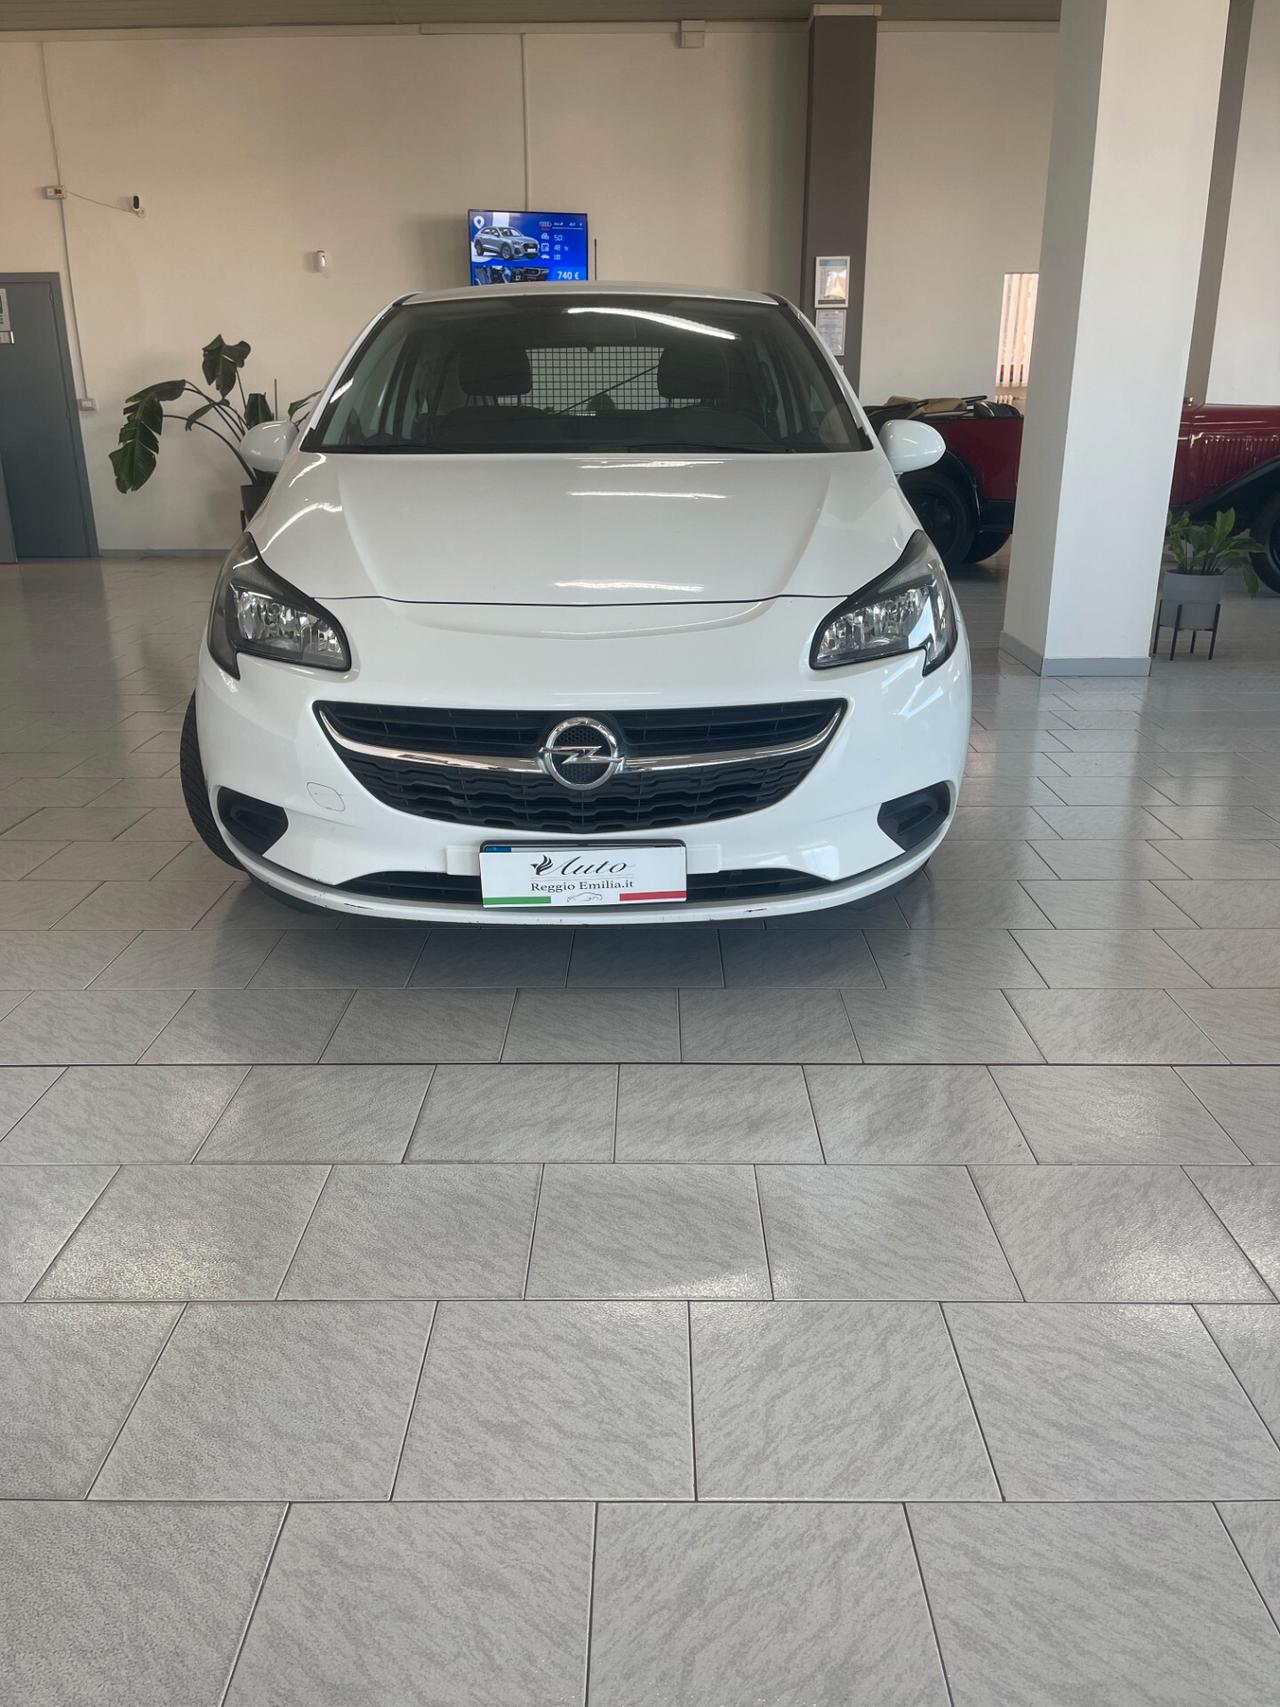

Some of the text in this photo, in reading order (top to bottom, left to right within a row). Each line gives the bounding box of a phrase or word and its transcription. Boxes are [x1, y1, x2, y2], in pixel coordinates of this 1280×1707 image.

[557, 271, 580, 280] 740 €
[545, 855, 633, 876] Auto
[531, 880, 633, 893] Reggio Emilia.it
